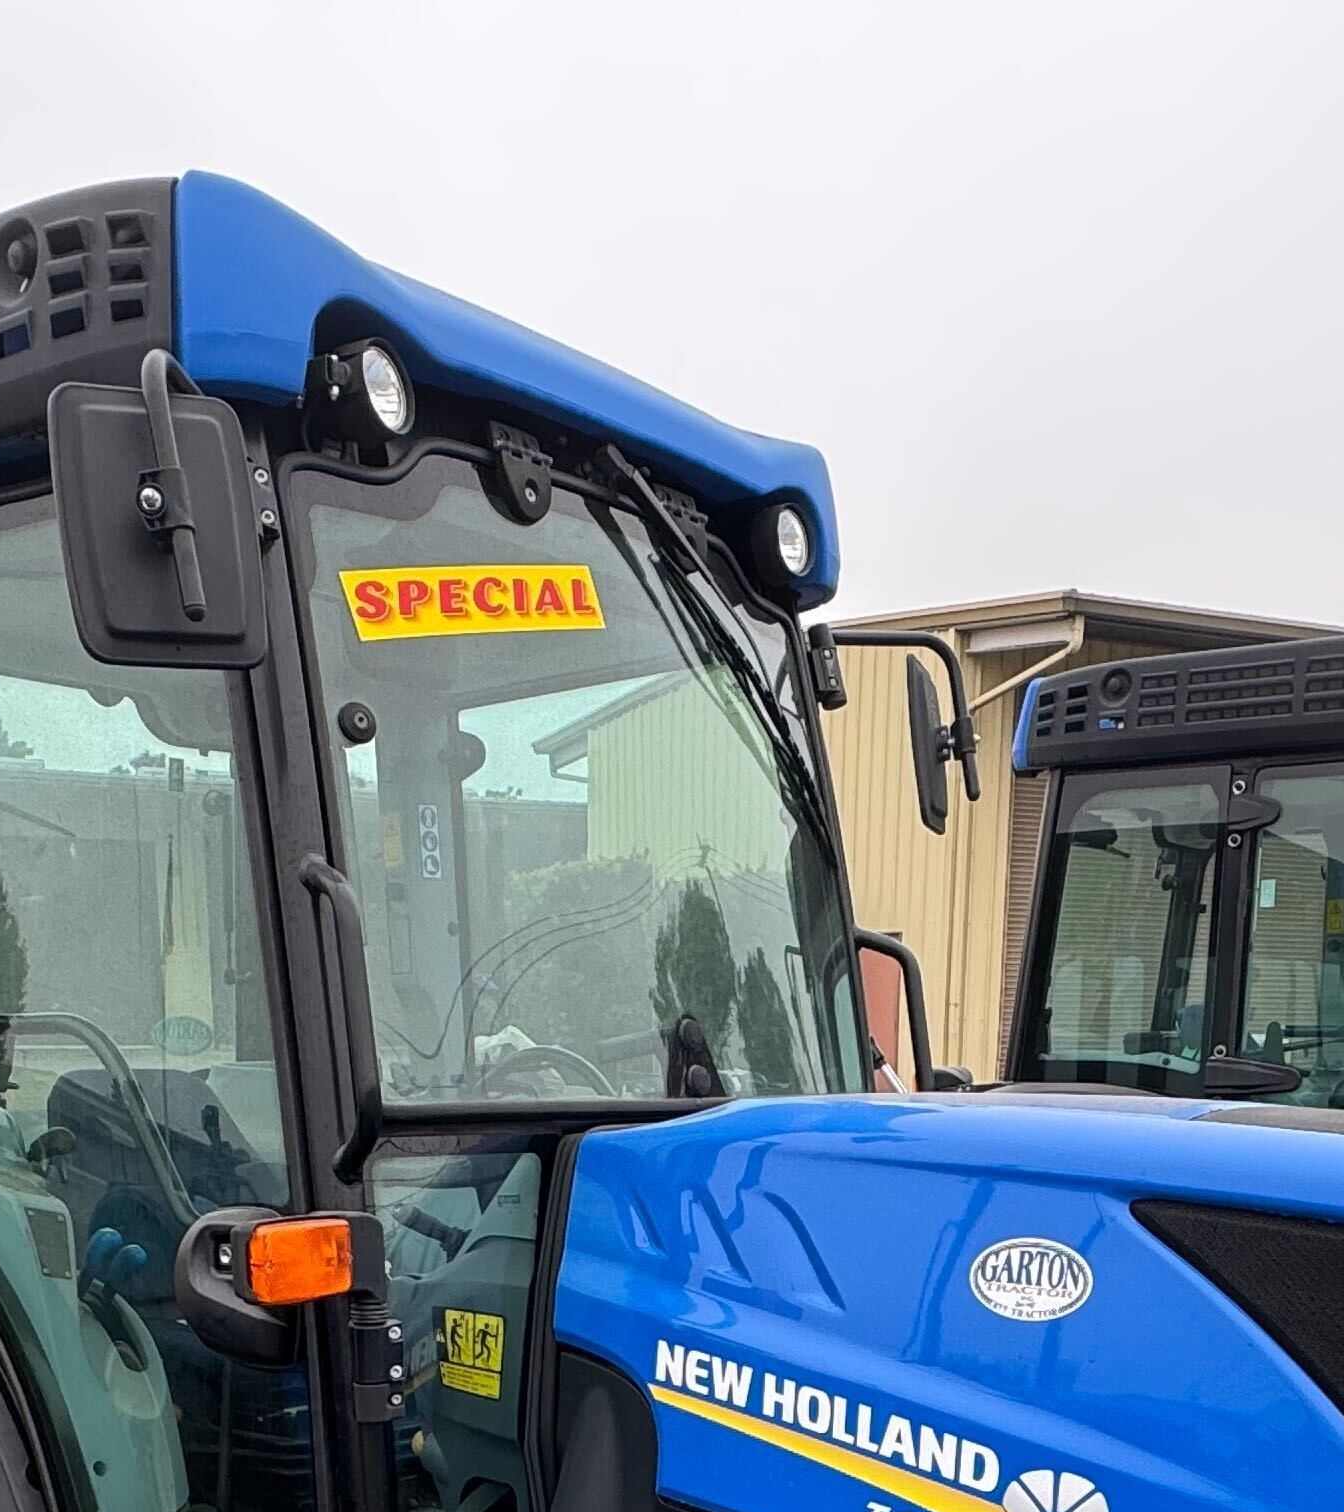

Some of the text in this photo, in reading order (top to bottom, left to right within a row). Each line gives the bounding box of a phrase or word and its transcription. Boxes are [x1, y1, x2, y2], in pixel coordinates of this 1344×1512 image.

[355, 577, 596, 622] SPECIAL
[980, 1247, 1081, 1292] GARTON
[984, 1281, 1074, 1299] TRACTOR
[655, 1339, 1001, 1494] NEW HOLLAND
